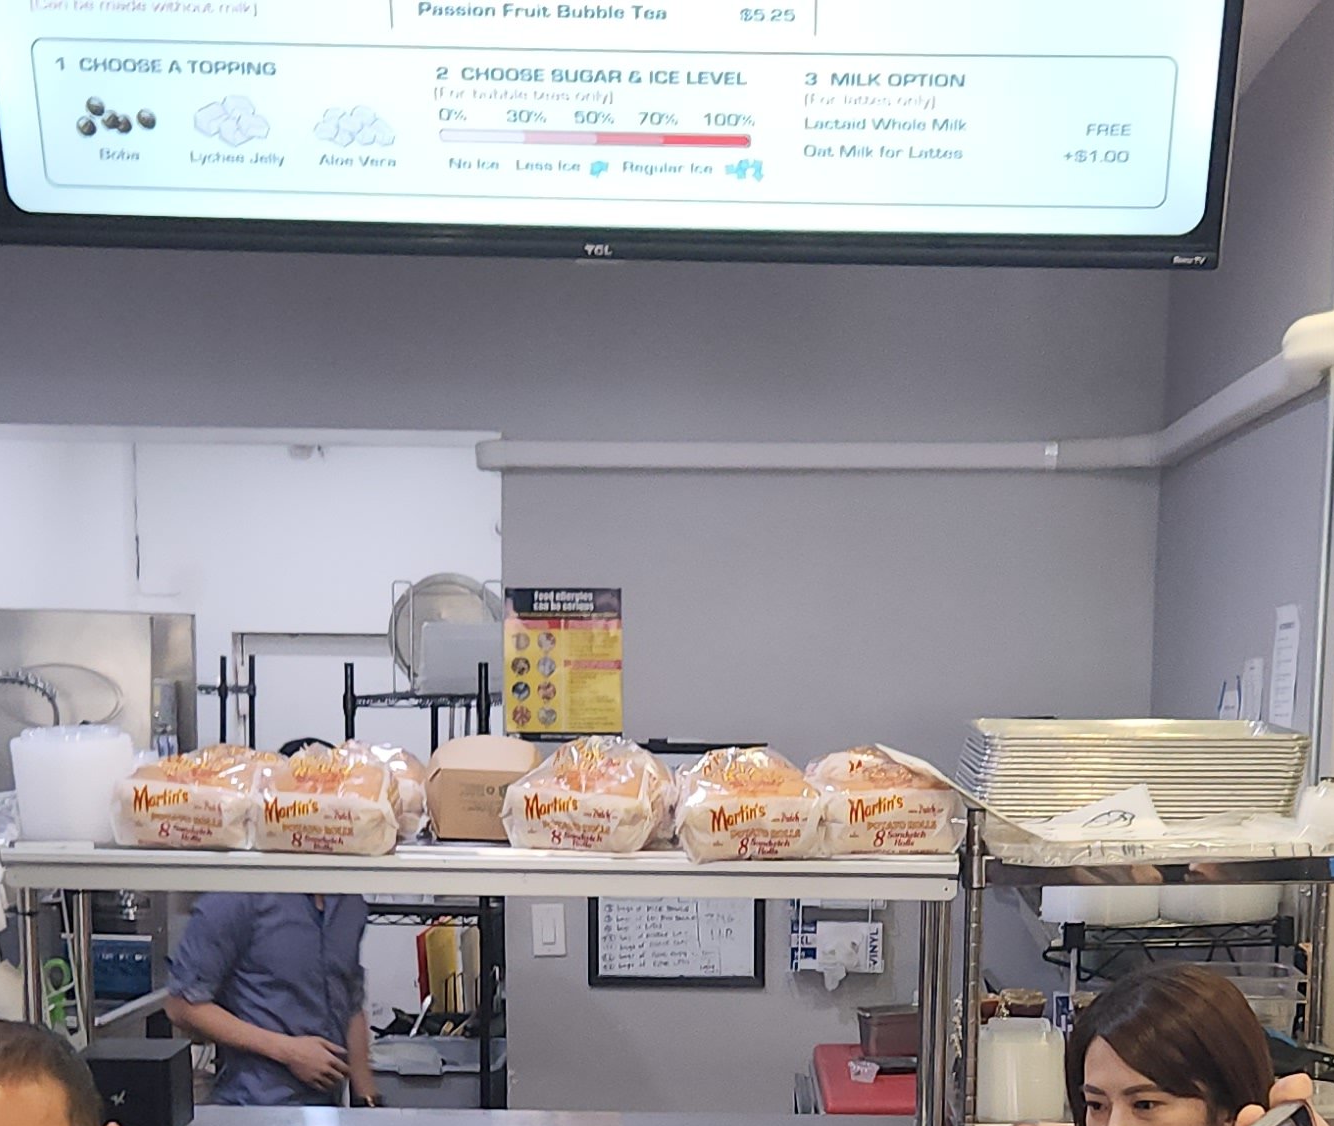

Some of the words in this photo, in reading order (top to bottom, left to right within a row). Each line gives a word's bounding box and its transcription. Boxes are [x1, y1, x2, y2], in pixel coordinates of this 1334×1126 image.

[417, 2, 496, 18] Passion
[501, 3, 551, 18] Fruit
[557, 4, 625, 20] Bubble
[631, 5, 668, 21] Tea
[55, 57, 66, 72] 1
[79, 57, 163, 73] CHOOSE
[168, 60, 182, 74] A
[187, 60, 278, 77] TOPPING
[435, 66, 449, 81] 2
[461, 66, 545, 83] CHOOSE
[551, 68, 623, 84] SUGAR
[628, 70, 643, 84] &
[650, 70, 680, 85] ICE
[686, 70, 748, 86] LEVEL
[804, 71, 818, 87] 3
[830, 72, 881, 88] MILK
[887, 72, 966, 88] OPTION
[438, 107, 468, 122] 0%
[506, 109, 547, 124] 30%
[574, 110, 615, 125] 50%
[638, 111, 679, 127] 70%
[703, 112, 756, 128] 100%
[804, 117, 866, 132] Lactaid
[871, 118, 927, 132] Whole
[932, 119, 967, 132] Milk
[1085, 123, 1132, 137] FREE
[99, 147, 141, 162] Boba
[249, 152, 285, 167] Jelly
[319, 153, 354, 167] Aloe
[358, 154, 397, 168] Vera
[803, 144, 835, 159] Oat
[839, 145, 874, 159] Milk
[879, 146, 904, 159] for
[909, 146, 964, 160] Lattes
[1063, 149, 1131, 164] +$1.00
[448, 157, 472, 171] No
[478, 158, 500, 171] Ice
[516, 158, 554, 172] Less
[558, 159, 581, 173] Ice
[622, 160, 685, 176] Regular
[689, 161, 713, 174] Ice
[133, 784, 190, 815] Martin's
[523, 792, 579, 821] Martin's
[263, 796, 320, 824] Martin's
[709, 802, 767, 833] Martin's
[847, 794, 904, 825] Martin's
[157, 823, 171, 838] 8
[290, 832, 302, 847] 8
[551, 830, 563, 845] 8
[873, 830, 886, 848] 8
[737, 838, 749, 856] 8
[869, 927, 879, 967] VINYL
